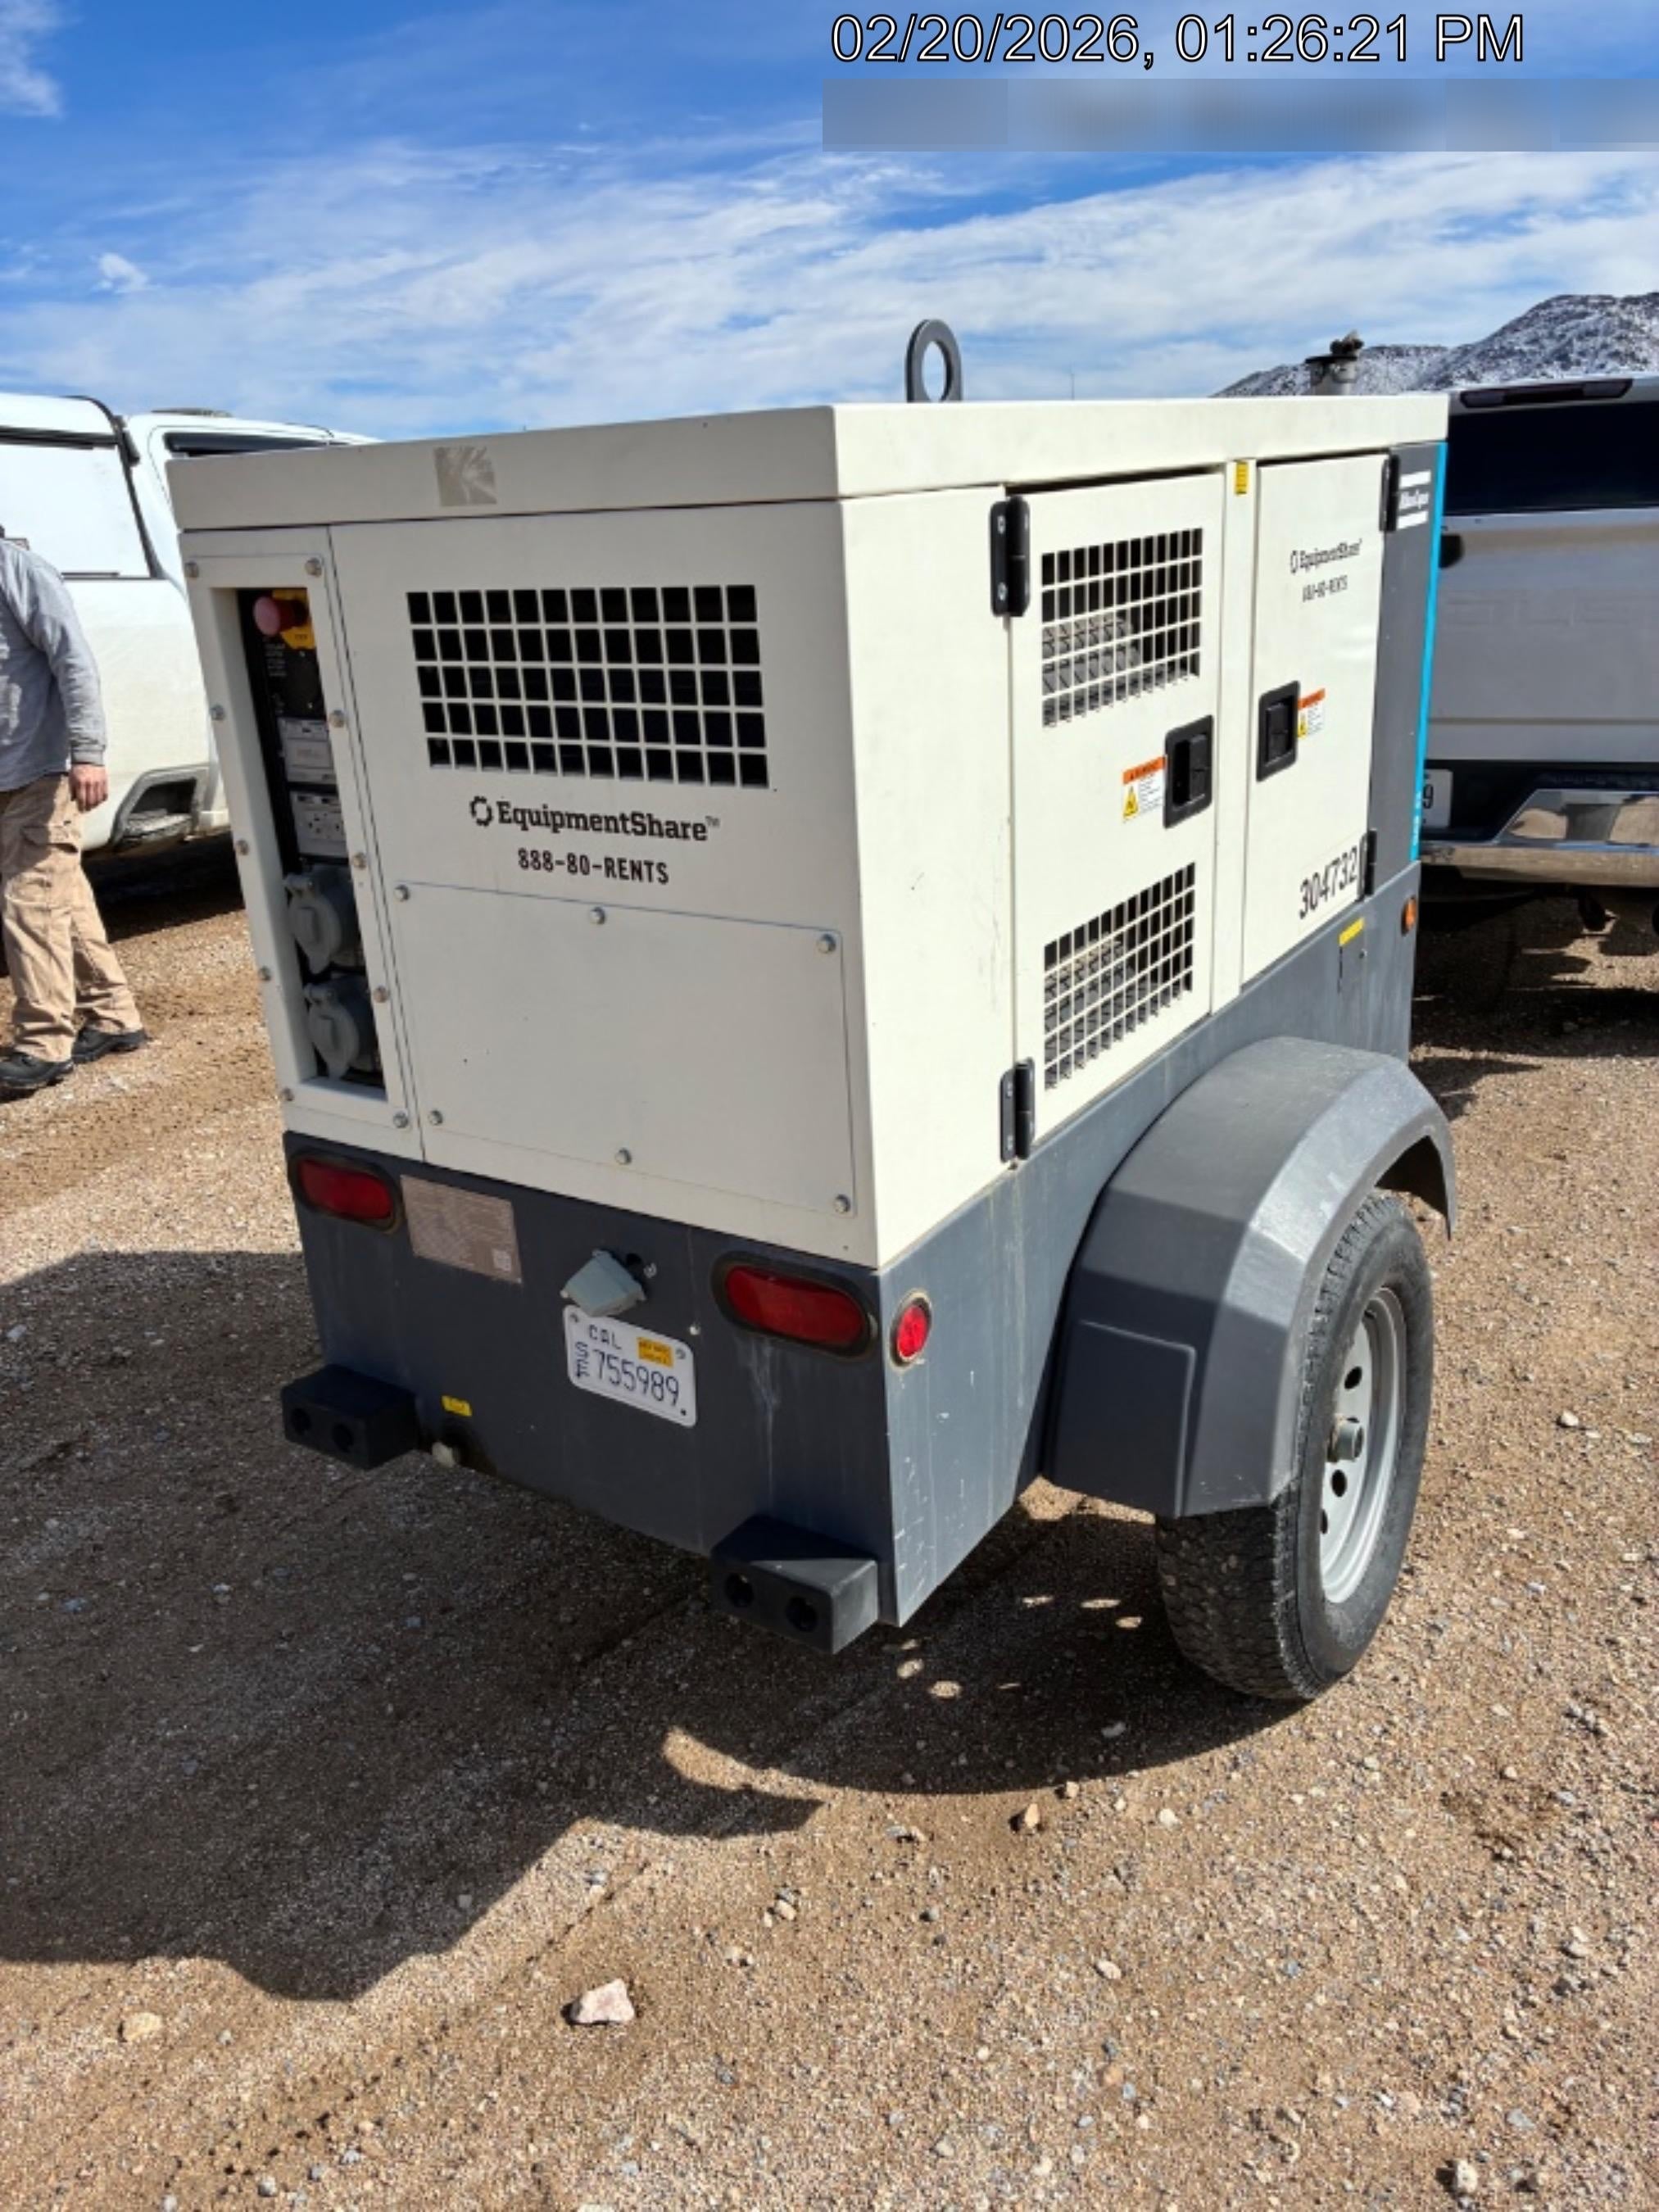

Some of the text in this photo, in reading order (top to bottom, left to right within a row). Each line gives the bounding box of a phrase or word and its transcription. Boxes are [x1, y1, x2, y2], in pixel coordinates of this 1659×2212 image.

[518, 846, 669, 885] 888-80-RENTS
[1299, 845, 1358, 919] 304732
[588, 1324, 622, 1350] CAL
[592, 1349, 680, 1407] 755989
